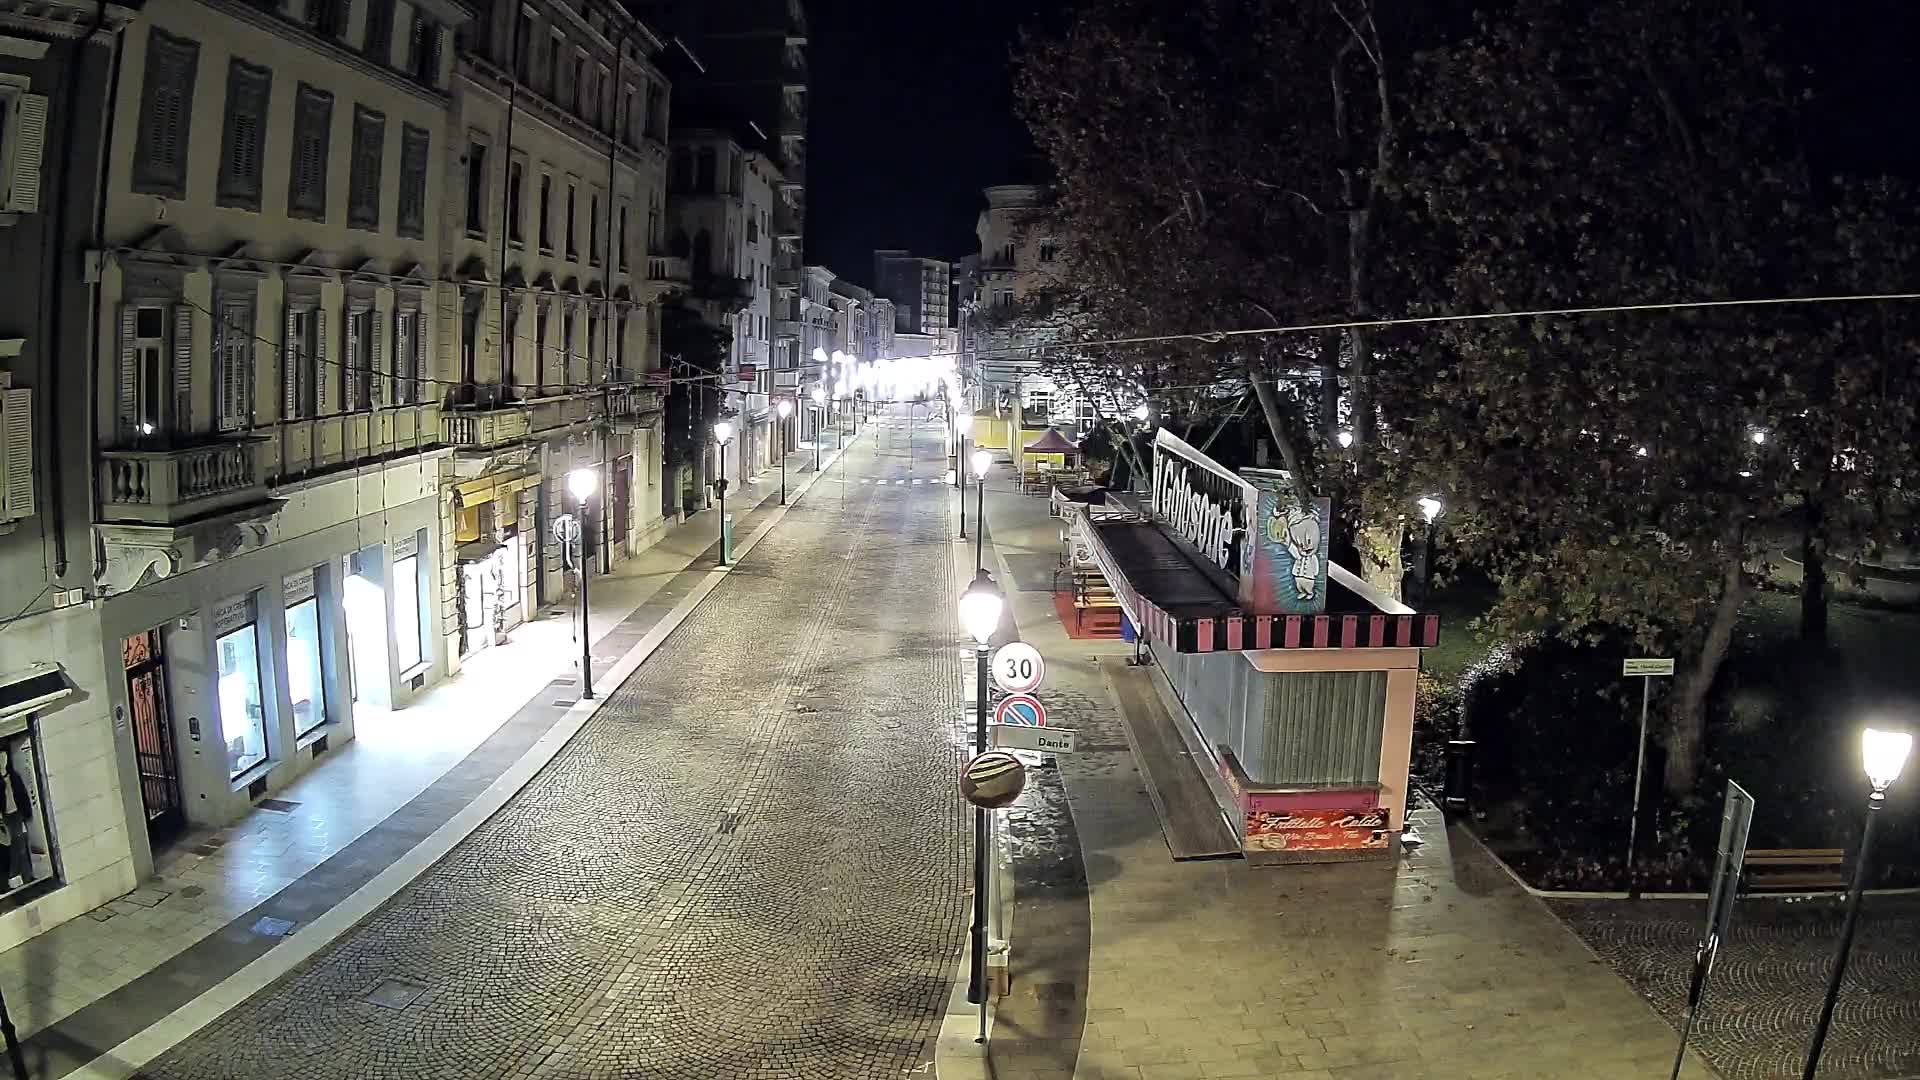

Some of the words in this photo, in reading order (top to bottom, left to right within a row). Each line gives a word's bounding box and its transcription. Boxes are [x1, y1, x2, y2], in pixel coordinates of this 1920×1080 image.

[1163, 458, 1233, 570] Golosone
[1006, 658, 1032, 679] 30
[1038, 737, 1070, 749] Dante
[1261, 815, 1327, 831] Frittelle
